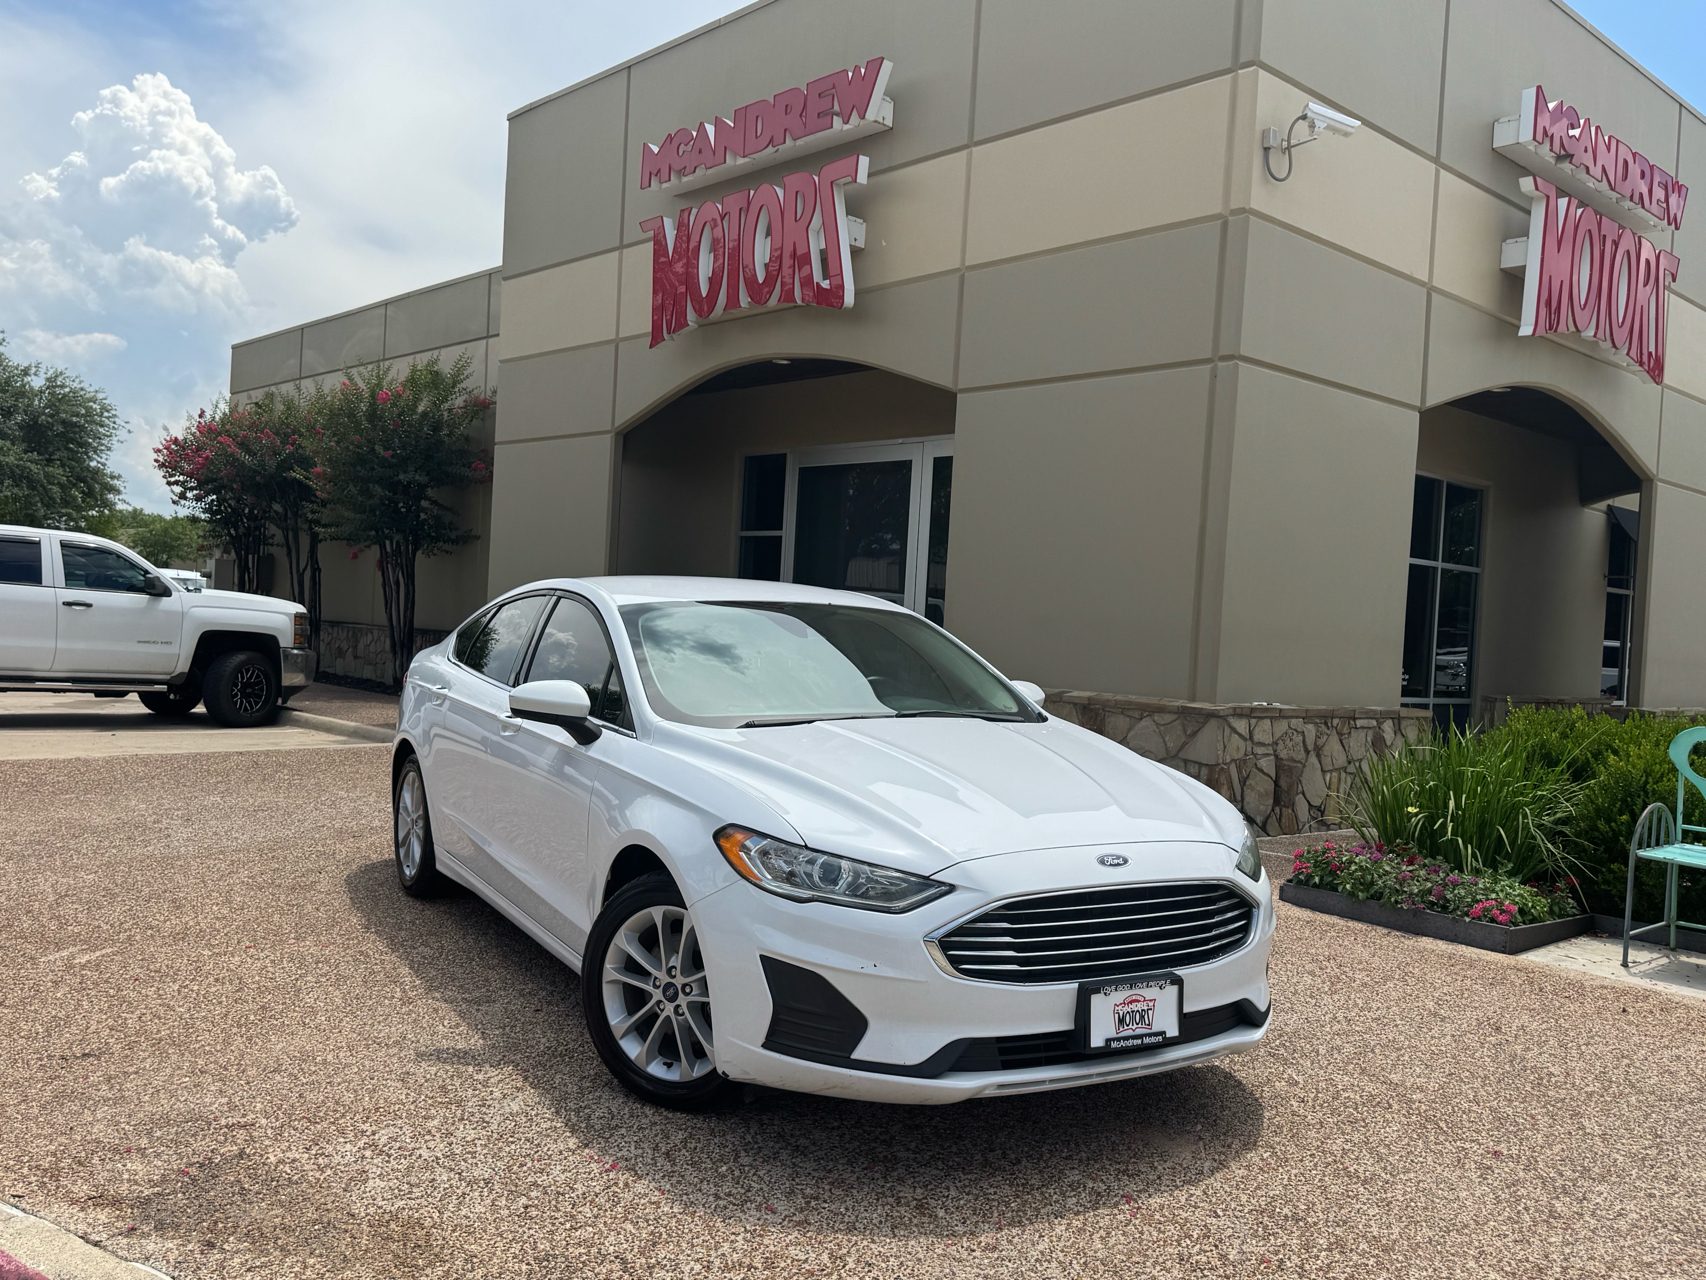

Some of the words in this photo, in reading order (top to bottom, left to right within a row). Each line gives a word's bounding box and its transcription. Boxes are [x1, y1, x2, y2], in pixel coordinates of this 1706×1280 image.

[639, 154, 859, 349] MOTORS
[1532, 176, 1680, 385] MOTORS
[1132, 982, 1147, 990] LOVE
[1115, 1008, 1152, 1031] MOTORS
[1110, 1039, 1142, 1048] McAndrew
[1143, 1035, 1163, 1044] Motors
